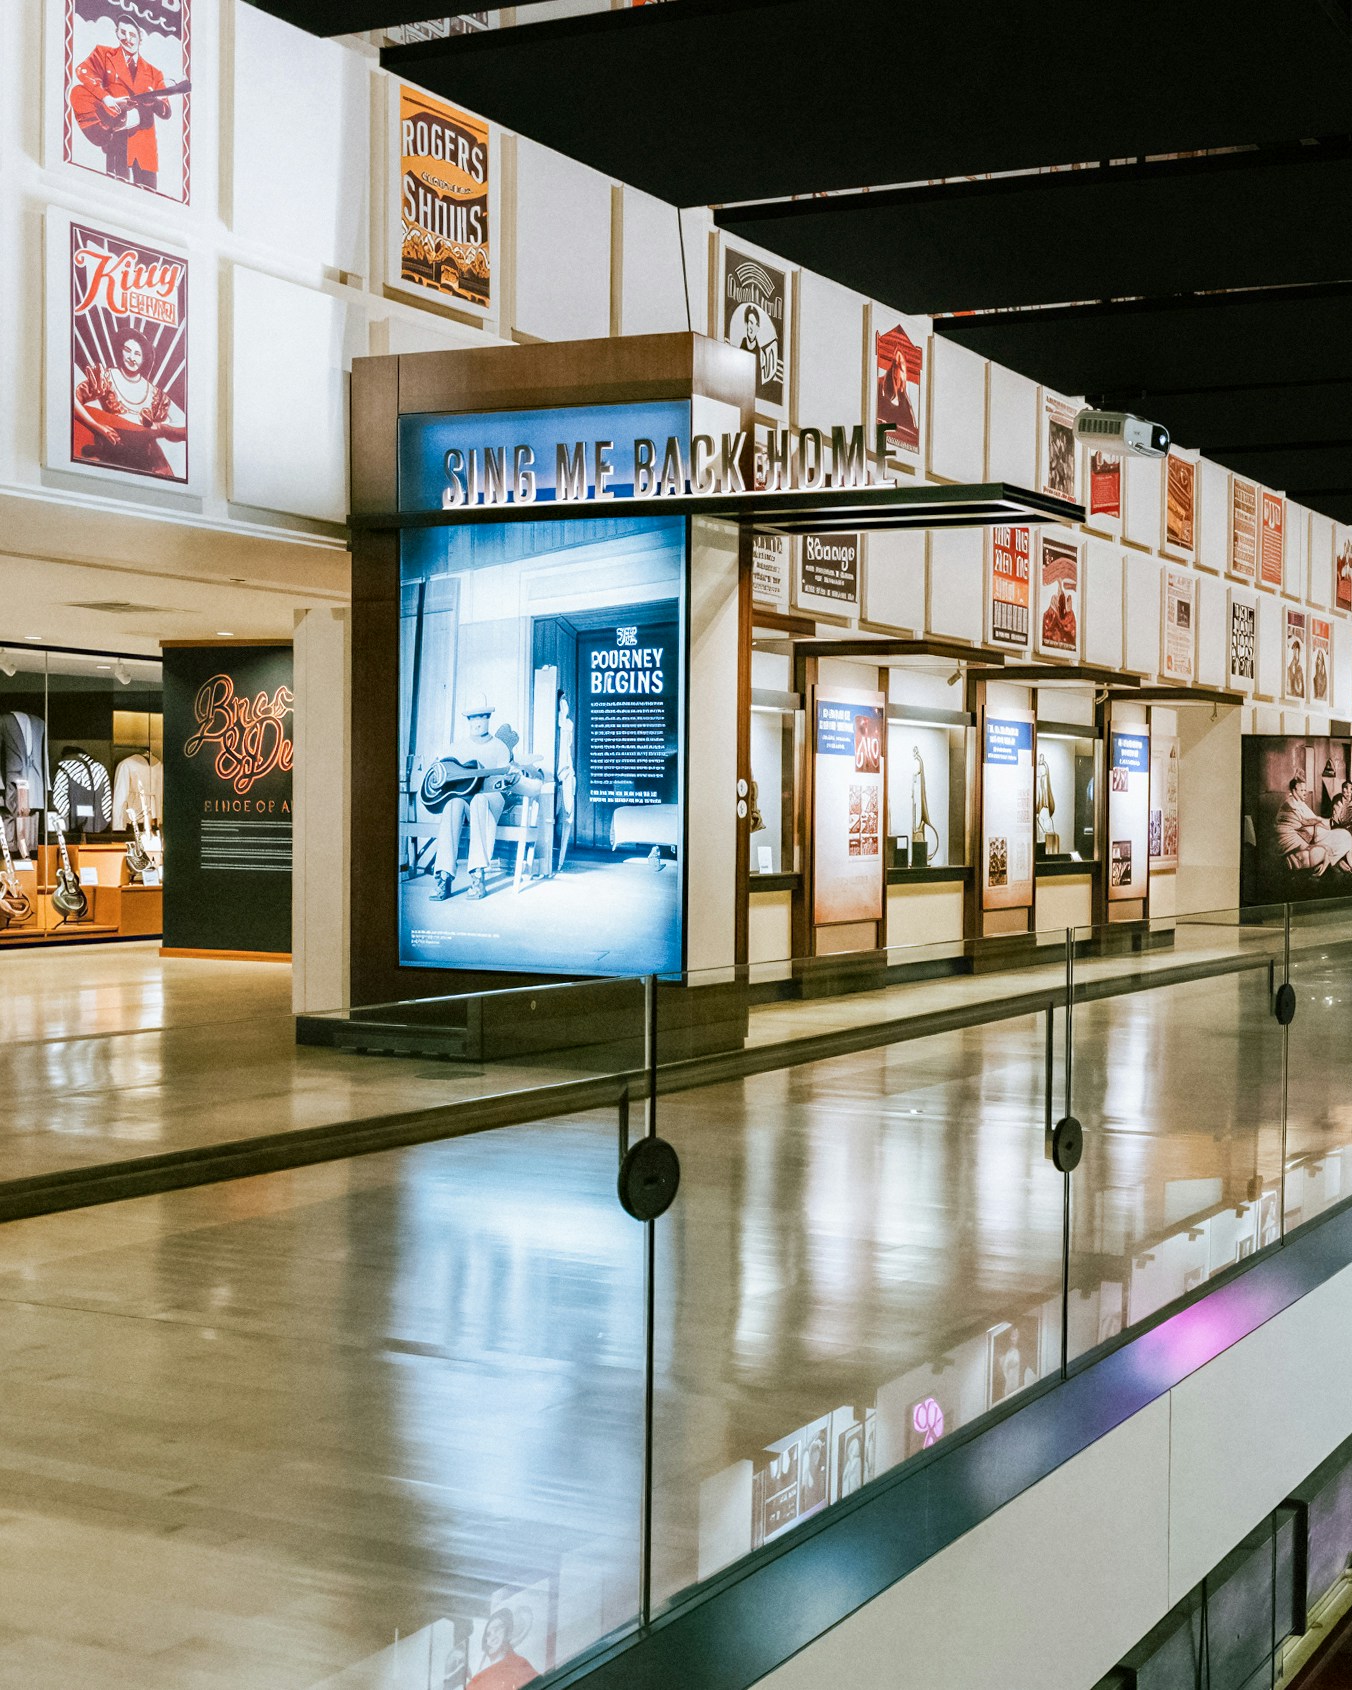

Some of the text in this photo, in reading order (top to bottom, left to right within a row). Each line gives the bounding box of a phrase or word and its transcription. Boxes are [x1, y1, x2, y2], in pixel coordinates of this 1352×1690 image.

[402, 119, 485, 185] ROGERS
[441, 422, 898, 508] SING ME BACK HOME
